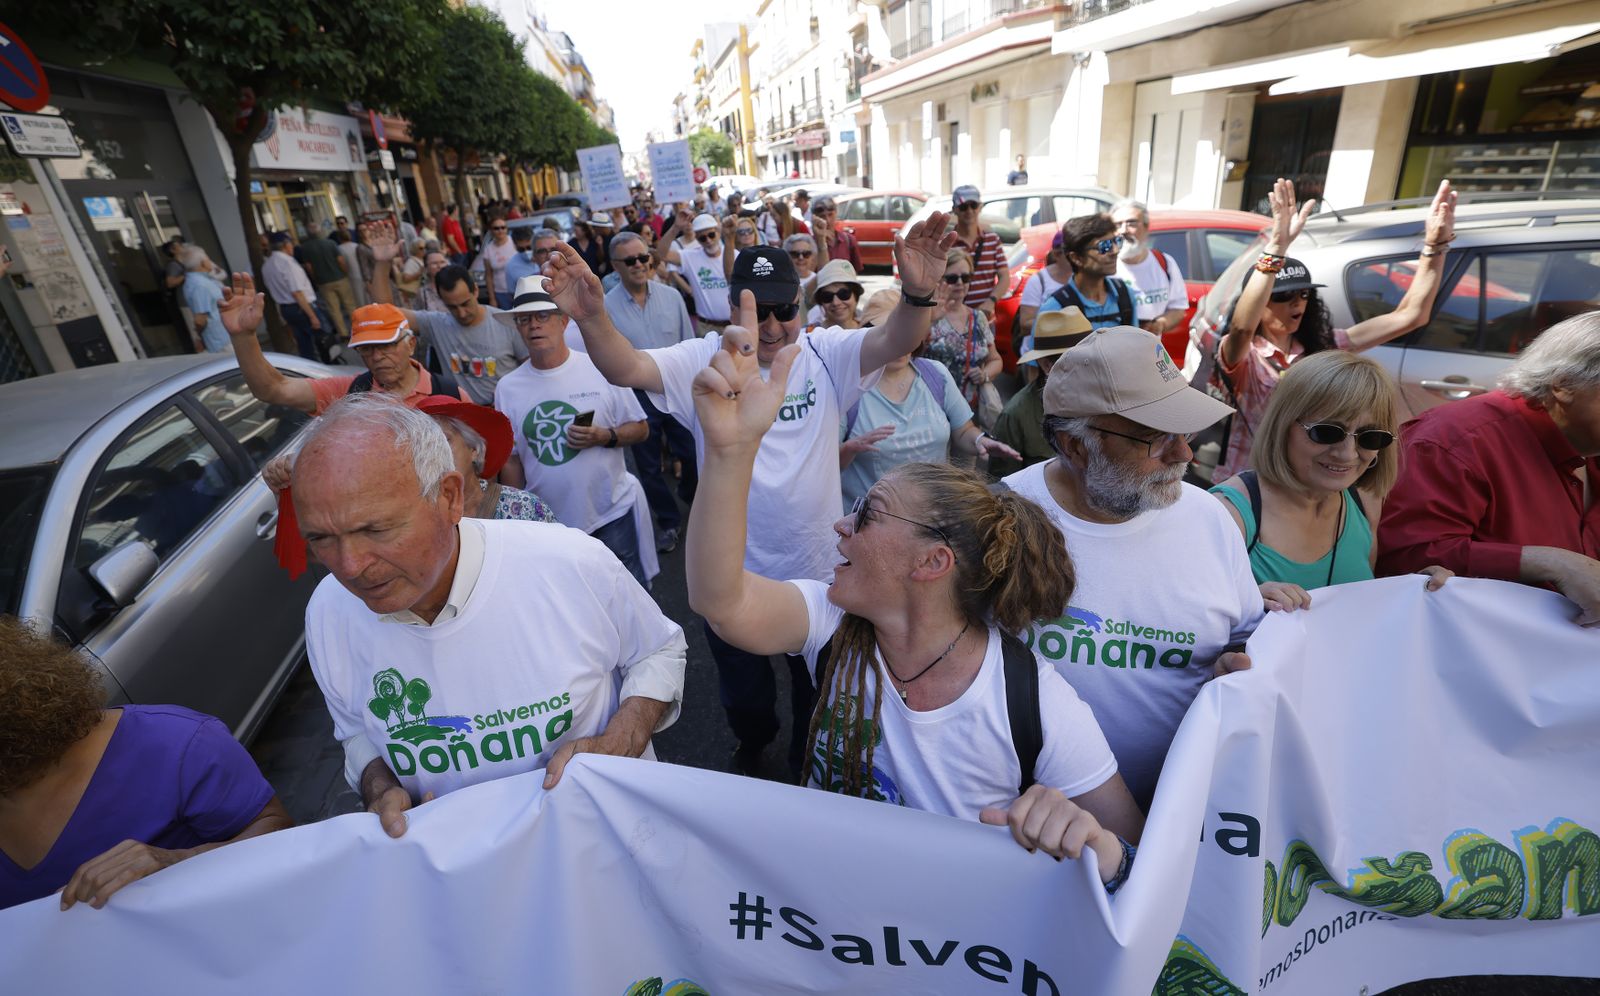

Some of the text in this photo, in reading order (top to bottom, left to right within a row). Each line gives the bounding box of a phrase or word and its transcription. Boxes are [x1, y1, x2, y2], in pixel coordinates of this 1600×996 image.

[97, 141, 124, 159] 152
[1104, 618, 1195, 645] Salvemos
[473, 692, 571, 731] Salvemos
[386, 709, 573, 776] Doñana
